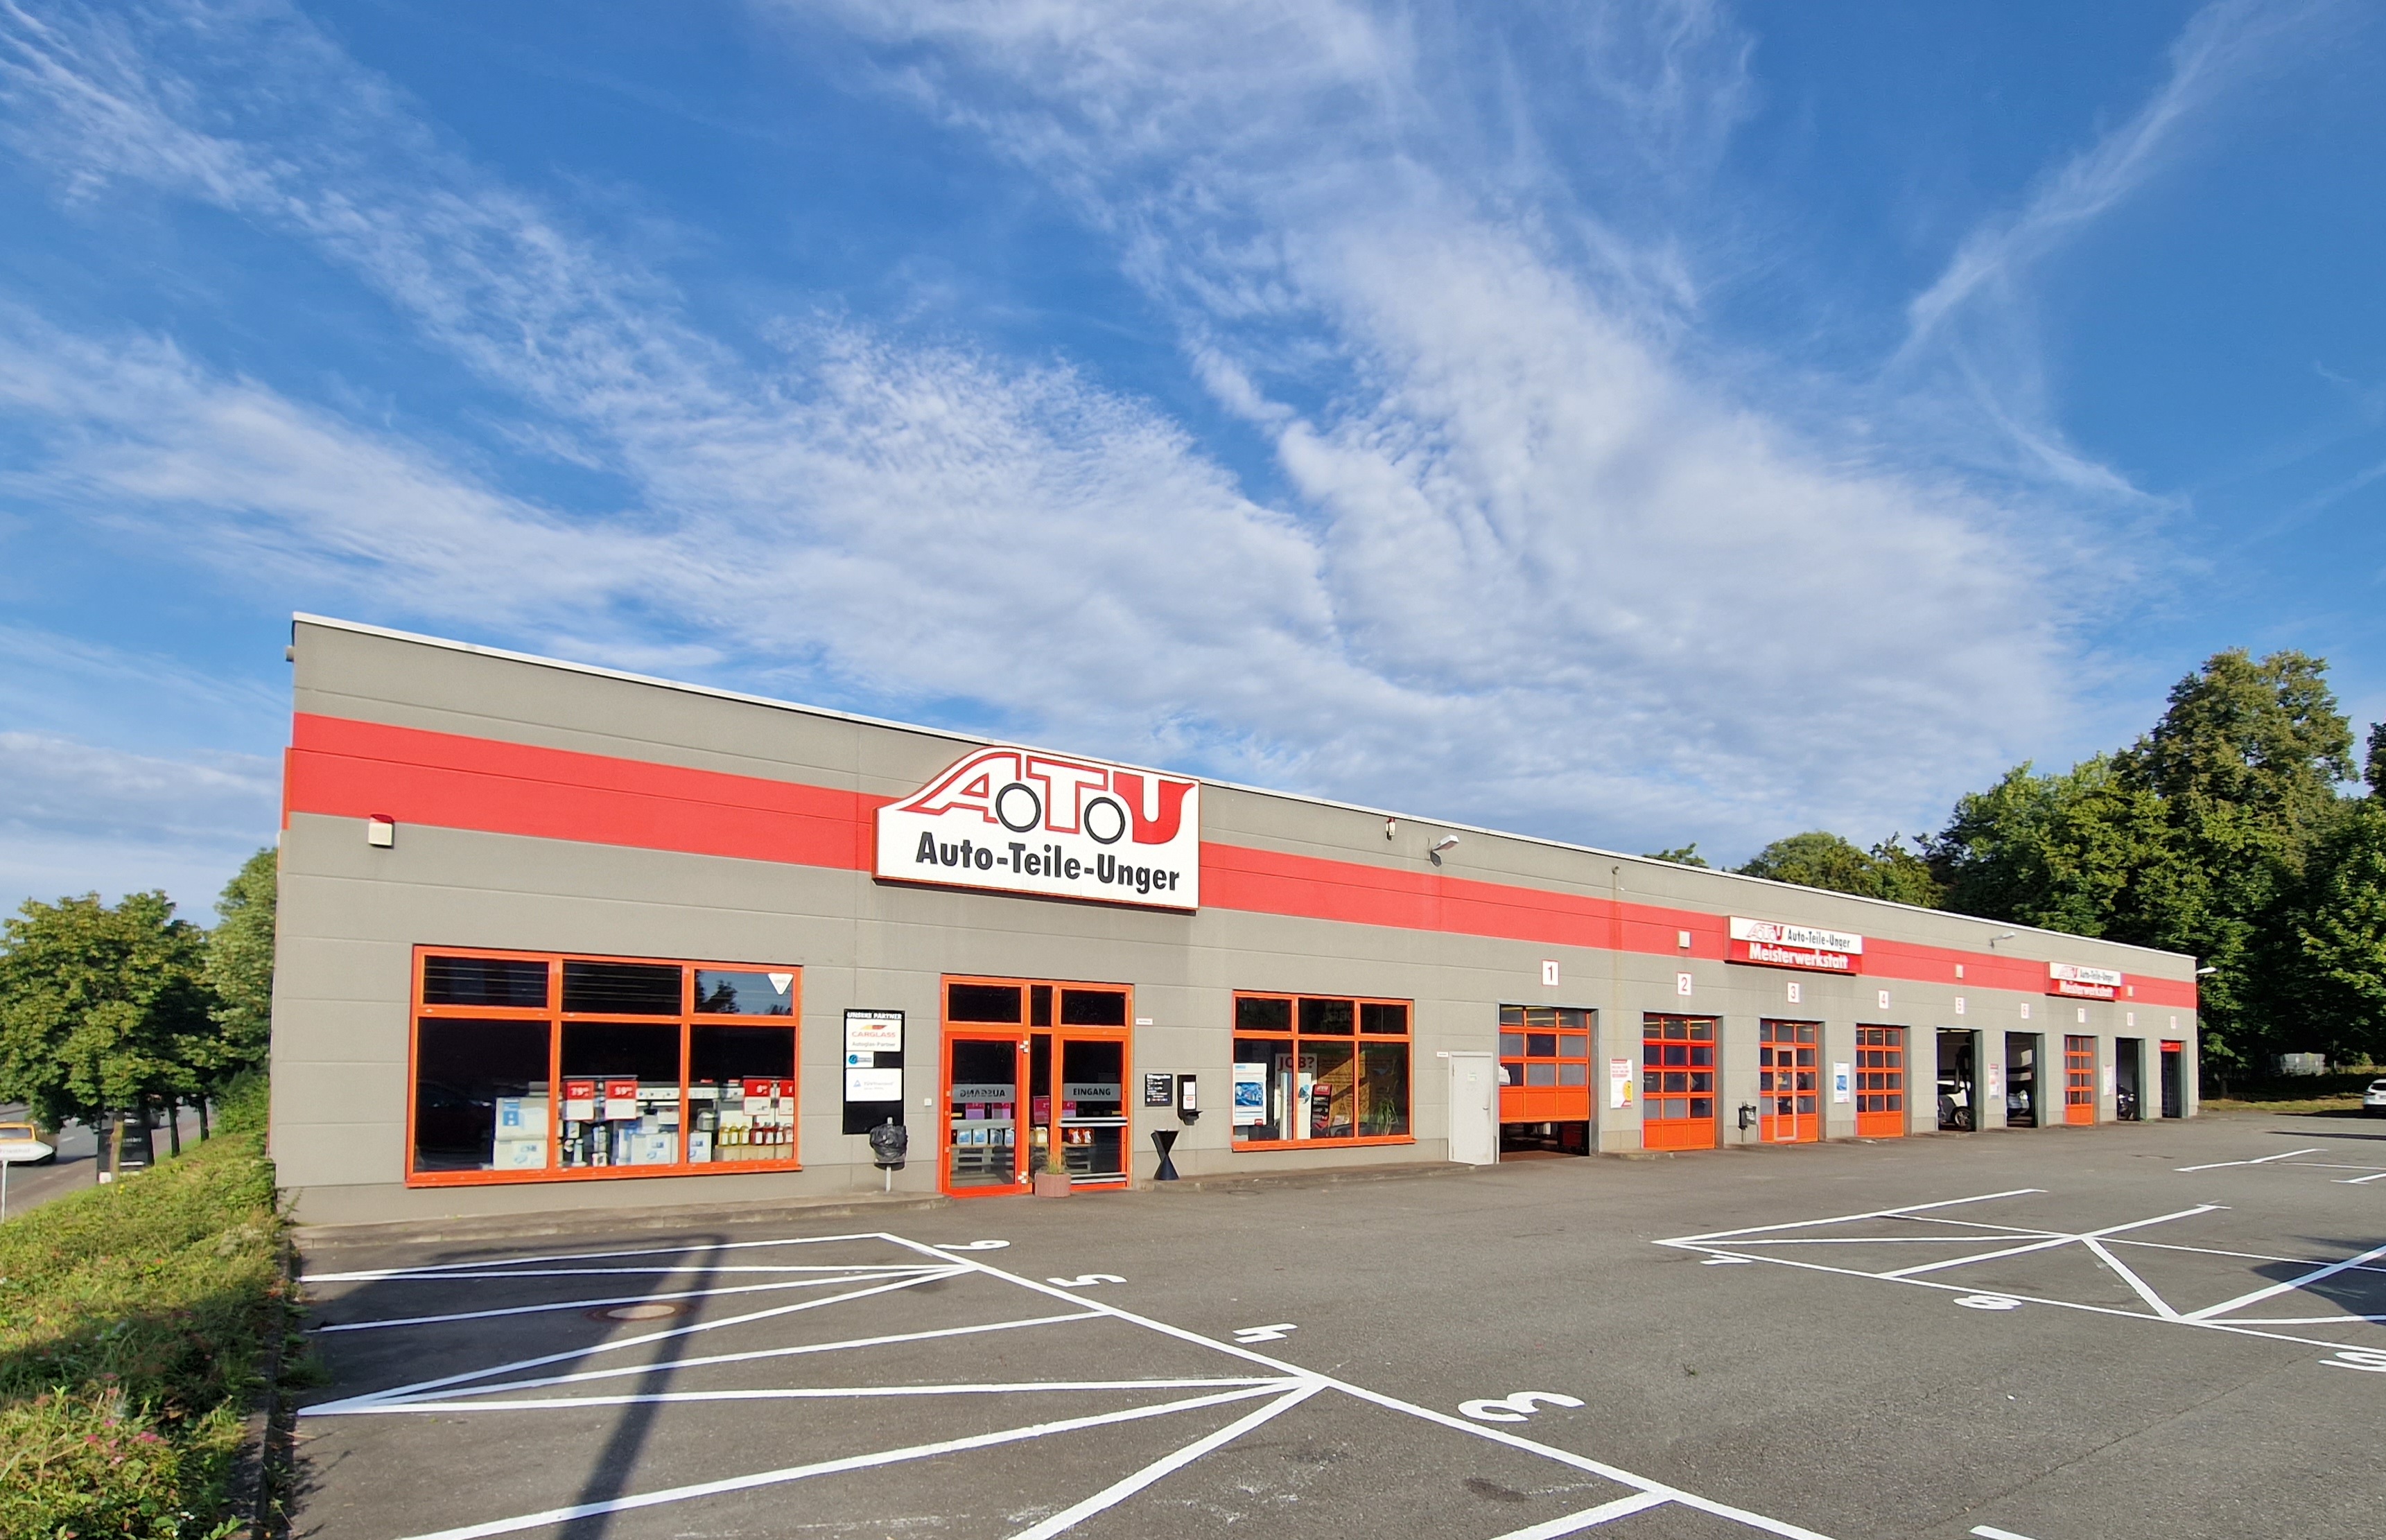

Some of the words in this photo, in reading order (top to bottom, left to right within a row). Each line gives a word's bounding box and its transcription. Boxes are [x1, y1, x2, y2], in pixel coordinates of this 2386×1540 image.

[916, 832, 1180, 894] Auto-Teile-Unger
[1787, 928, 1850, 950] Auto-Teile-Unger
[1749, 943, 1849, 970] Meisterwerkstatt
[1548, 965, 1553, 981] 1
[1681, 977, 1687, 992] 2
[1791, 986, 1796, 999] 3
[1881, 993, 1886, 1005] 4
[1958, 999, 1962, 1011] 5
[1278, 1056, 1314, 1071] JOB?
[1072, 1087, 1111, 1096] EINGANG
[1047, 1274, 1128, 1287] 5
[1458, 1391, 1585, 1422] 3
